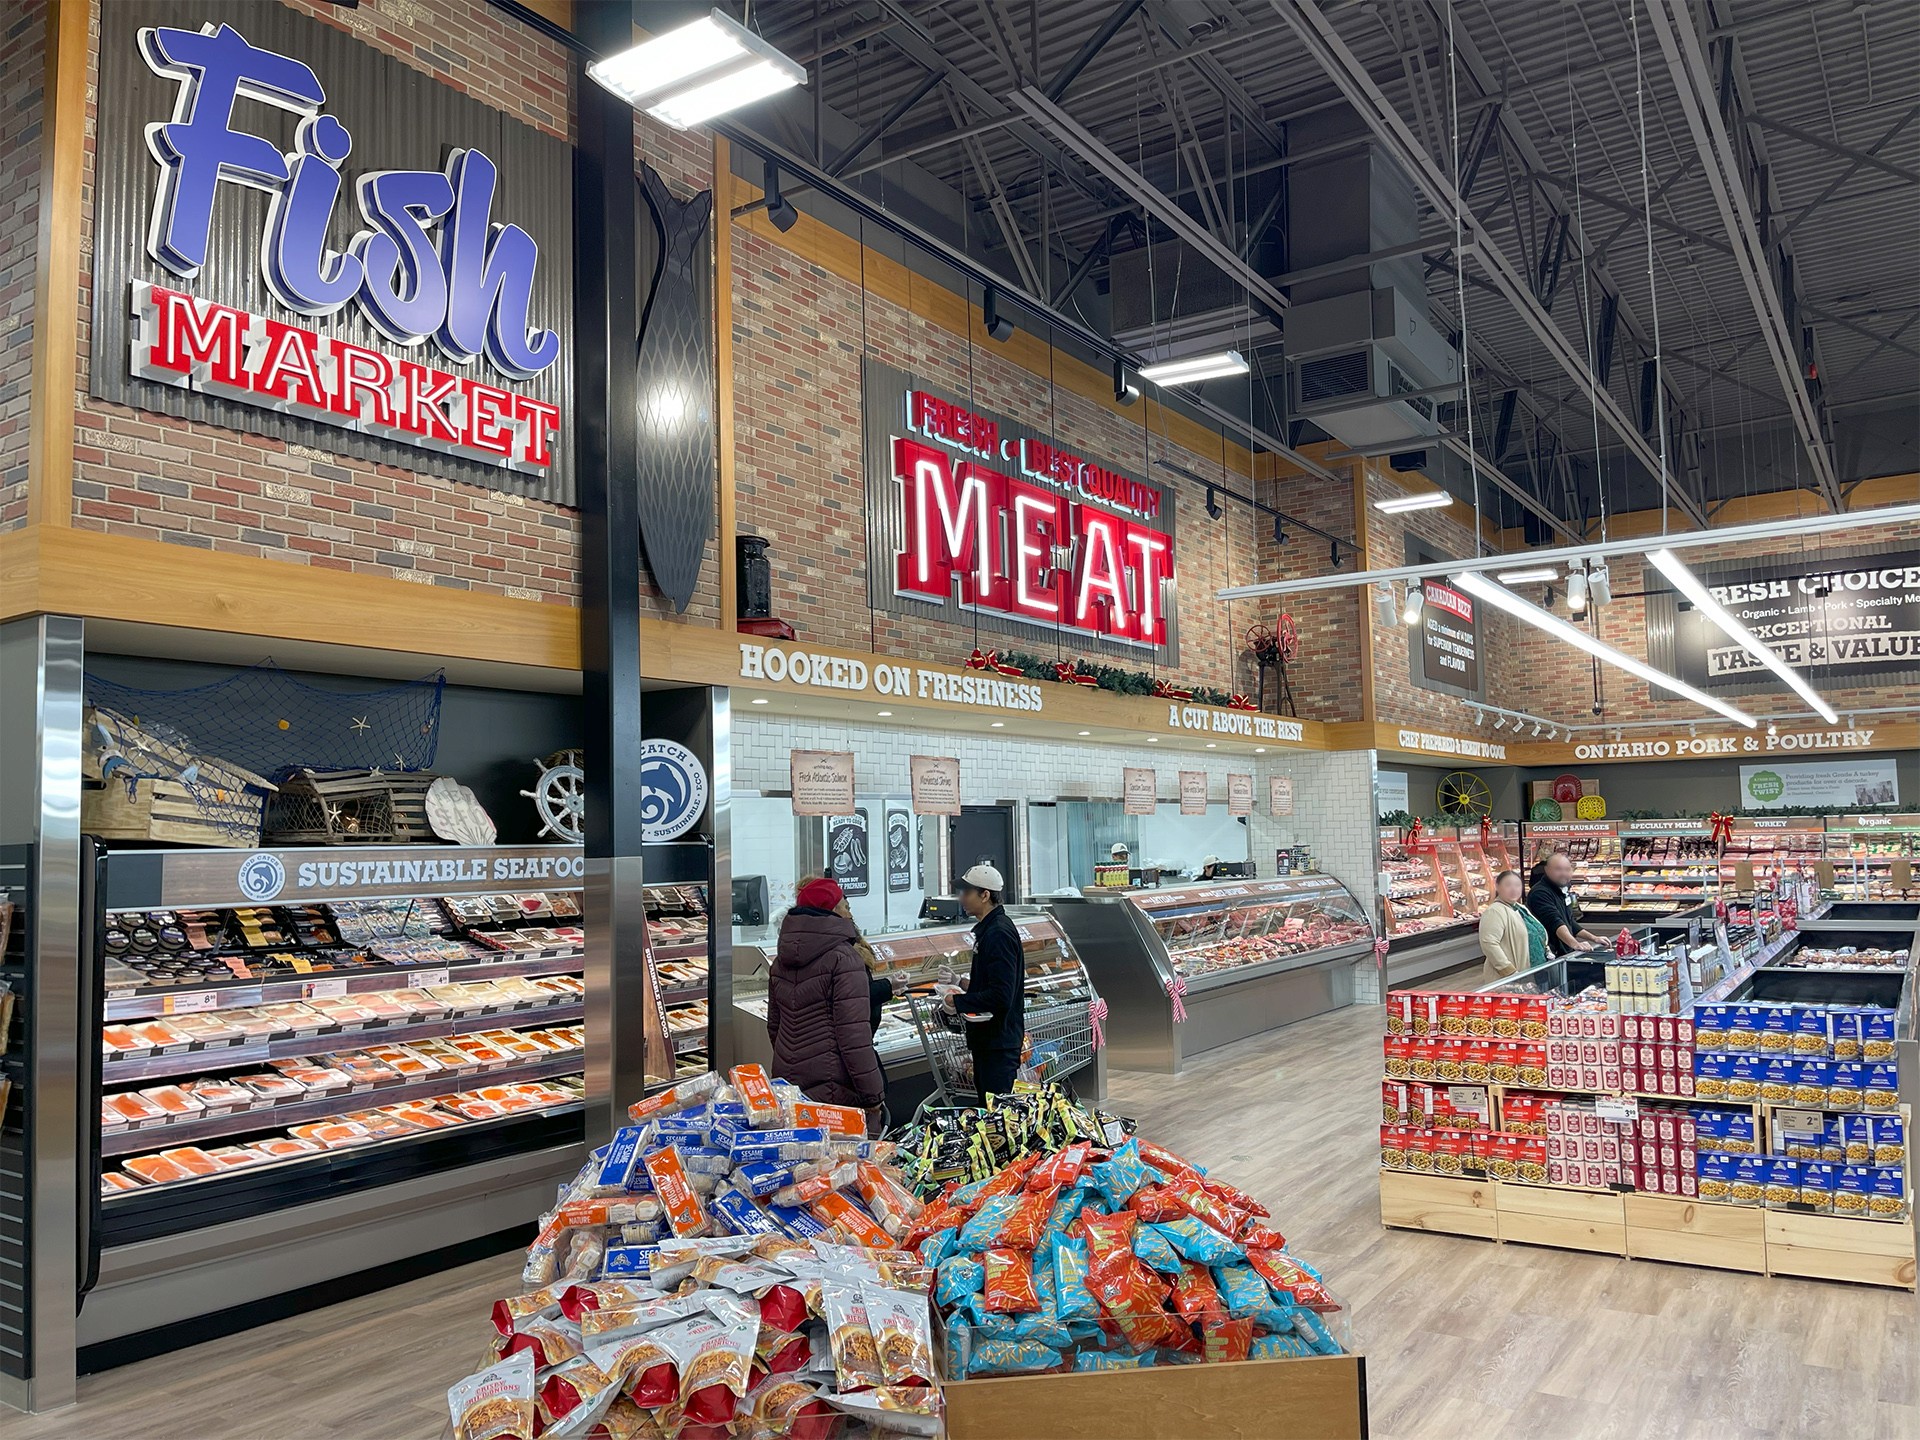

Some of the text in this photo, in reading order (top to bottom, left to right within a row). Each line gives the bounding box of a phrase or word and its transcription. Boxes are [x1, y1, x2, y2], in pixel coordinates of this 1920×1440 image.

[138, 22, 560, 380] Fish
[132, 280, 560, 475] MARKET
[906, 390, 1162, 519] FRESH BEST QUALITY
[891, 435, 1173, 648] MEAT
[1426, 585, 1456, 610] CANADIAN
[1697, 580, 1790, 608] RESH
[1742, 607, 1780, 620] Organic
[1788, 604, 1815, 614] Lamb
[1824, 601, 1847, 611] Pork
[1856, 596, 1903, 609] Specialty
[1749, 615, 1892, 639] EXCEPTIONAL
[1808, 643, 1825, 660] &
[739, 643, 1043, 712] HOOKED ON FRESHNESS
[1169, 705, 1303, 741] A CUT ABOVE THE REST
[1398, 729, 1420, 748] CHEF
[1420, 733, 1455, 753] PREPARED
[1574, 730, 1874, 760] ONTARIO PORK & POULTRY
[1753, 788, 1779, 796] TWIST
[654, 799, 700, 837] SUSTAINABLE
[241, 855, 279, 878] GOOD CATCH
[298, 856, 584, 888] SUSTAINABLE SEAFOO
[645, 947, 669, 1039] SUSTAINABLE SEAFOOD
[815, 1108, 844, 1121] ORIGINAL
[717, 1134, 733, 1147] SESA
[619, 1143, 634, 1164] SESAME
[633, 1176, 649, 1184] SESAME
[760, 1183, 780, 1194] SESAME
[568, 1216, 591, 1225] NATURE
[716, 1209, 734, 1228] SESAME
[838, 1211, 868, 1236] ORIGINAL
[541, 1228, 559, 1246] ATURE
[640, 1249, 661, 1260] SES
[851, 1306, 865, 1315] CRIS
[475, 1380, 506, 1395] CRISPY
[488, 1385, 520, 1397] ONIONS
